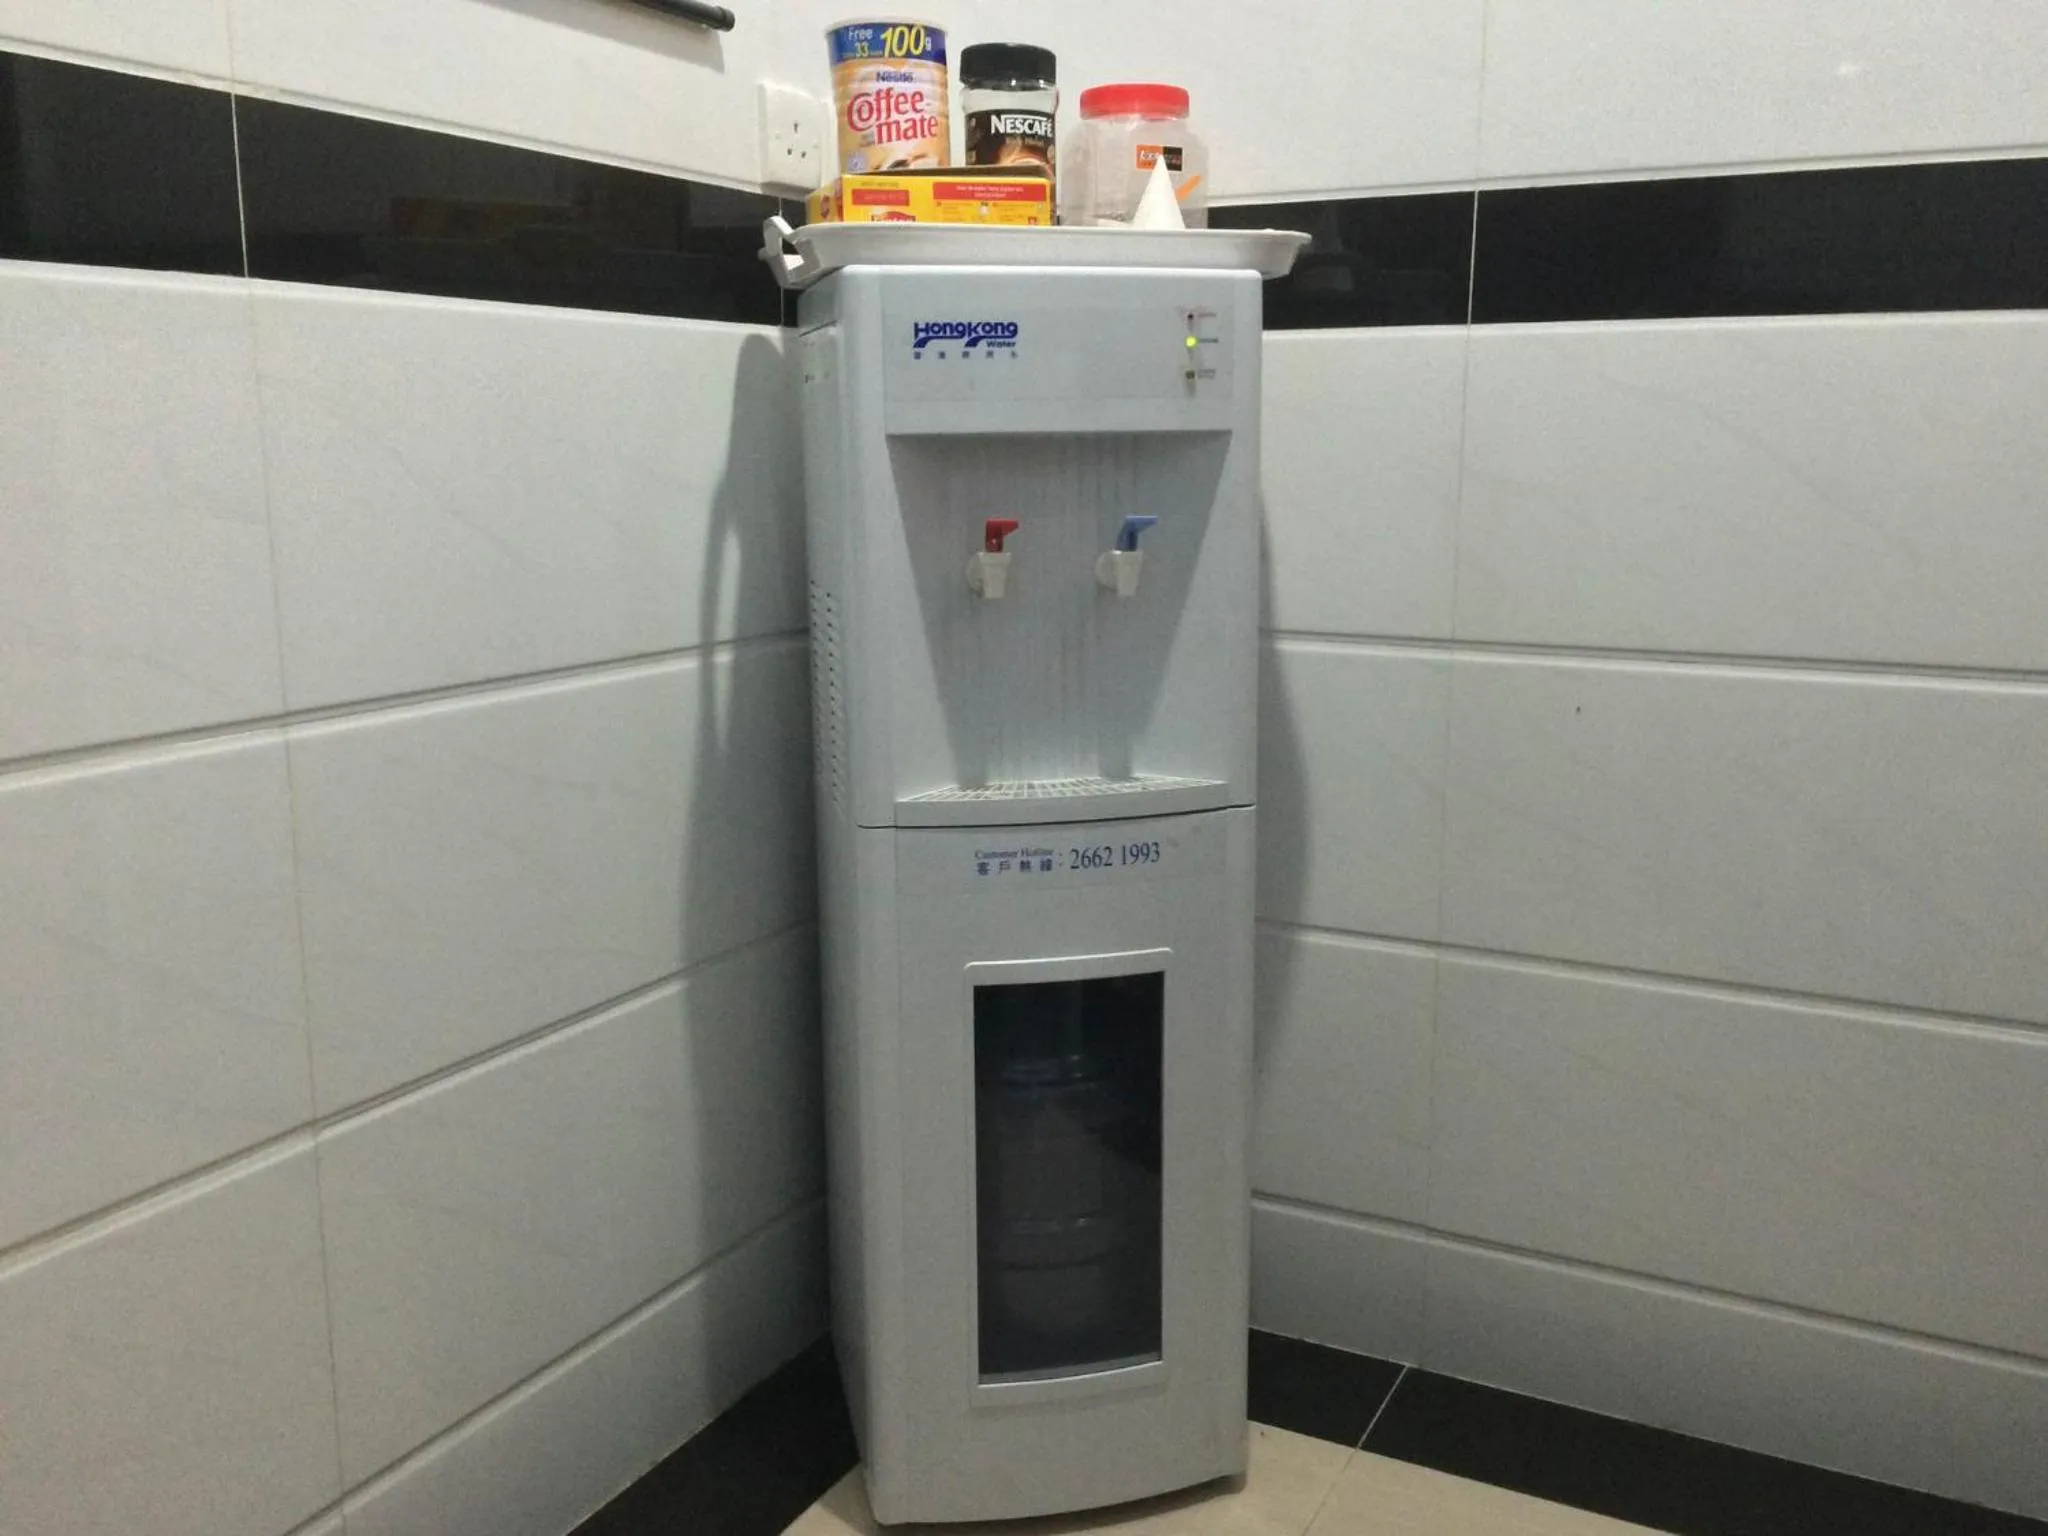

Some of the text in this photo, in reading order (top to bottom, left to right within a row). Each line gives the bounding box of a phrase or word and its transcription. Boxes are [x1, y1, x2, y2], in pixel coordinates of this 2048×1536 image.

[847, 27, 873, 41] Free
[876, 115, 939, 145] mate
[1069, 841, 1161, 870] 2662 1993
